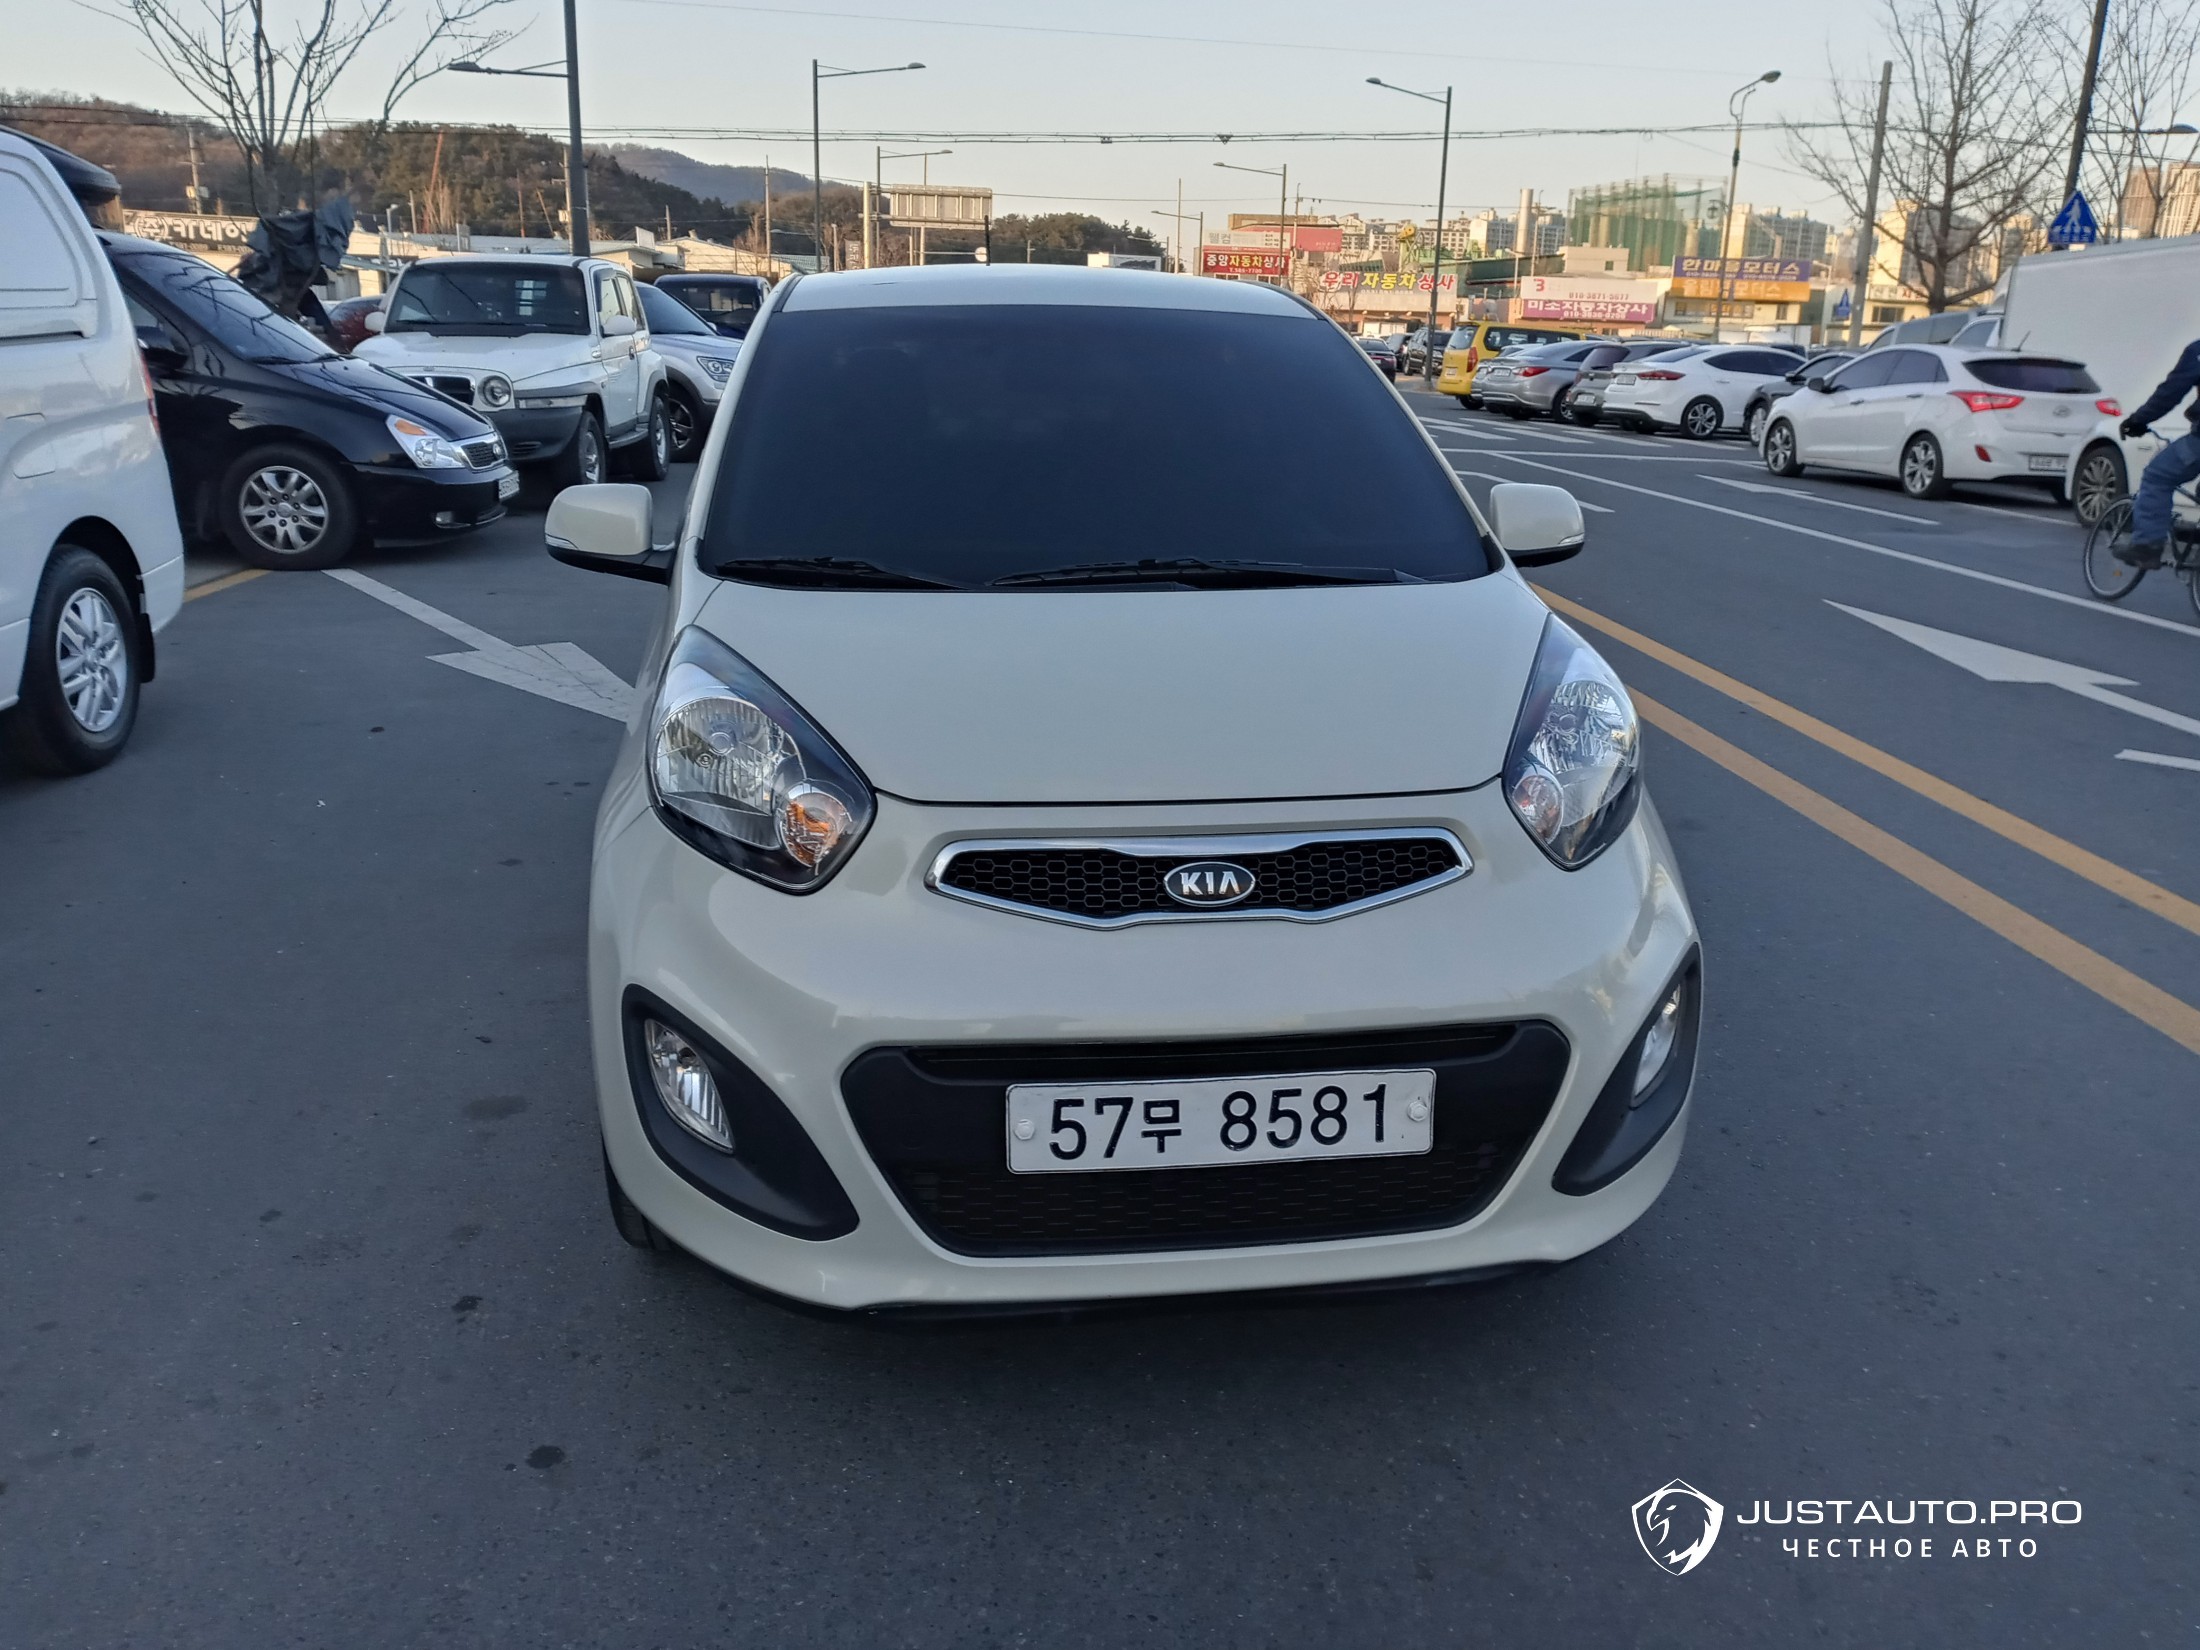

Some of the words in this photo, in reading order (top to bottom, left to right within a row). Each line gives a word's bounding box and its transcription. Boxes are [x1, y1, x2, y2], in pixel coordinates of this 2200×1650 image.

[1180, 871, 1241, 895] KIA
[1049, 1096, 1182, 1160] 57무
[1220, 1083, 1387, 1152] 8581
